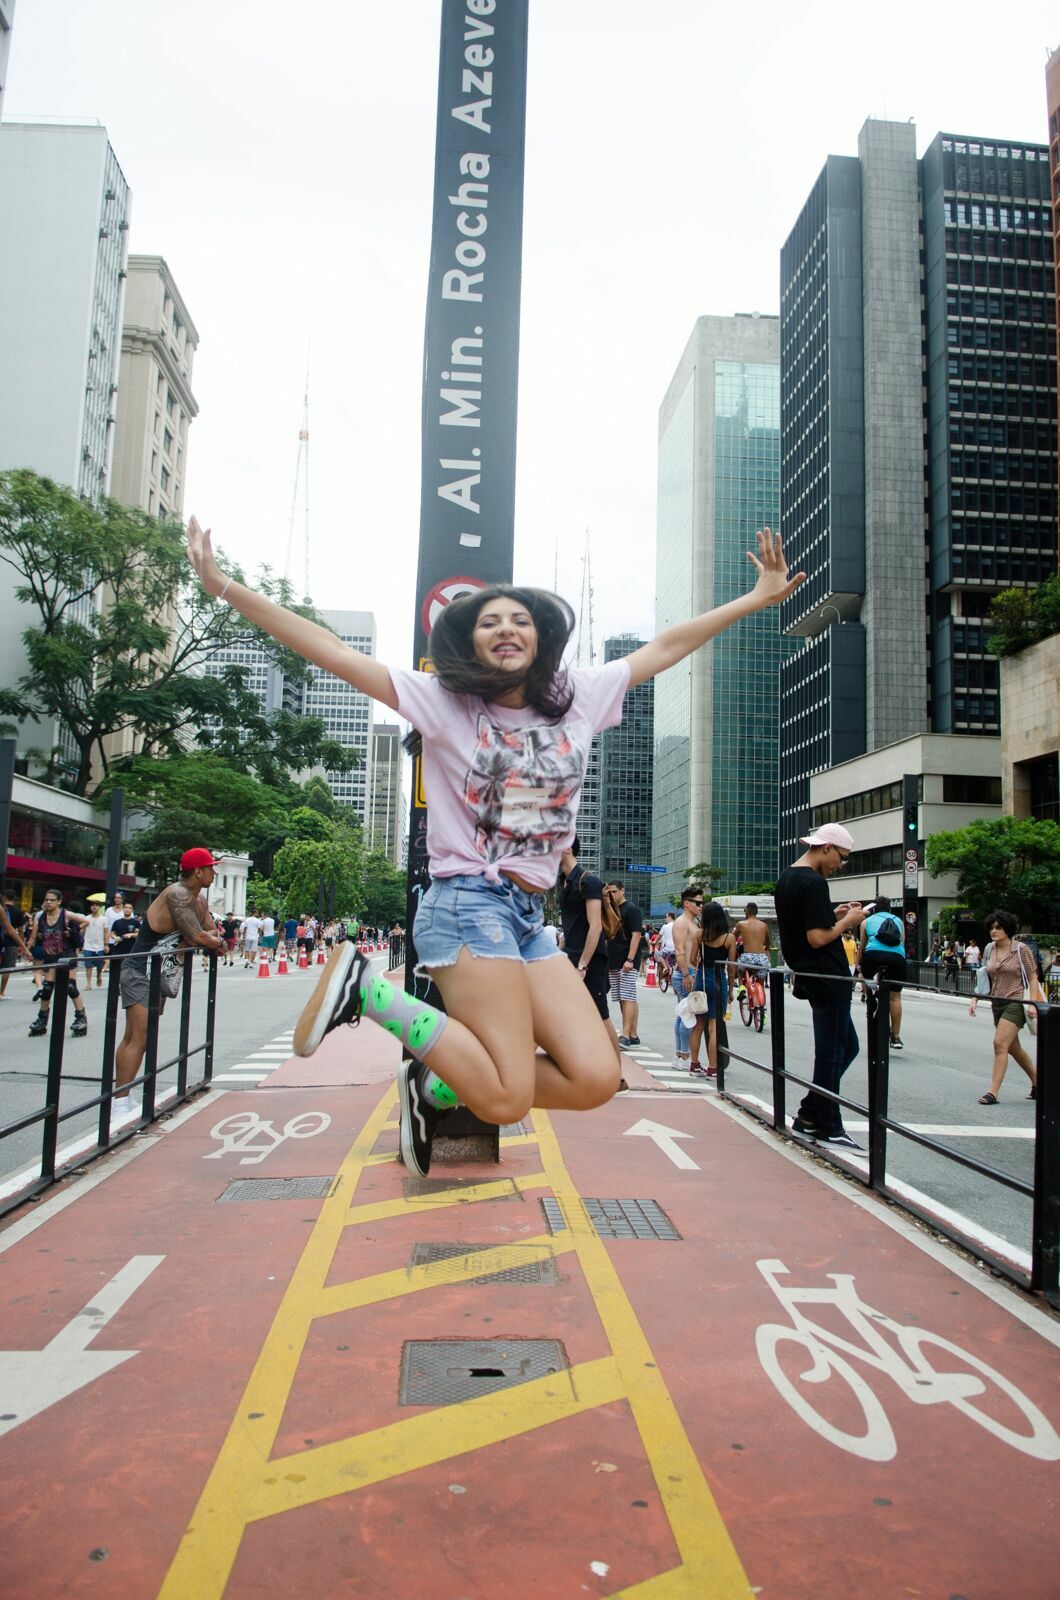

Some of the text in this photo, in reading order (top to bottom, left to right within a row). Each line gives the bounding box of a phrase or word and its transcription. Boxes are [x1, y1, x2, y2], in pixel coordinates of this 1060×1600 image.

[442, 152, 490, 303] Rocha
[439, 326, 483, 428] Min.
[437, 447, 482, 514] Al.
